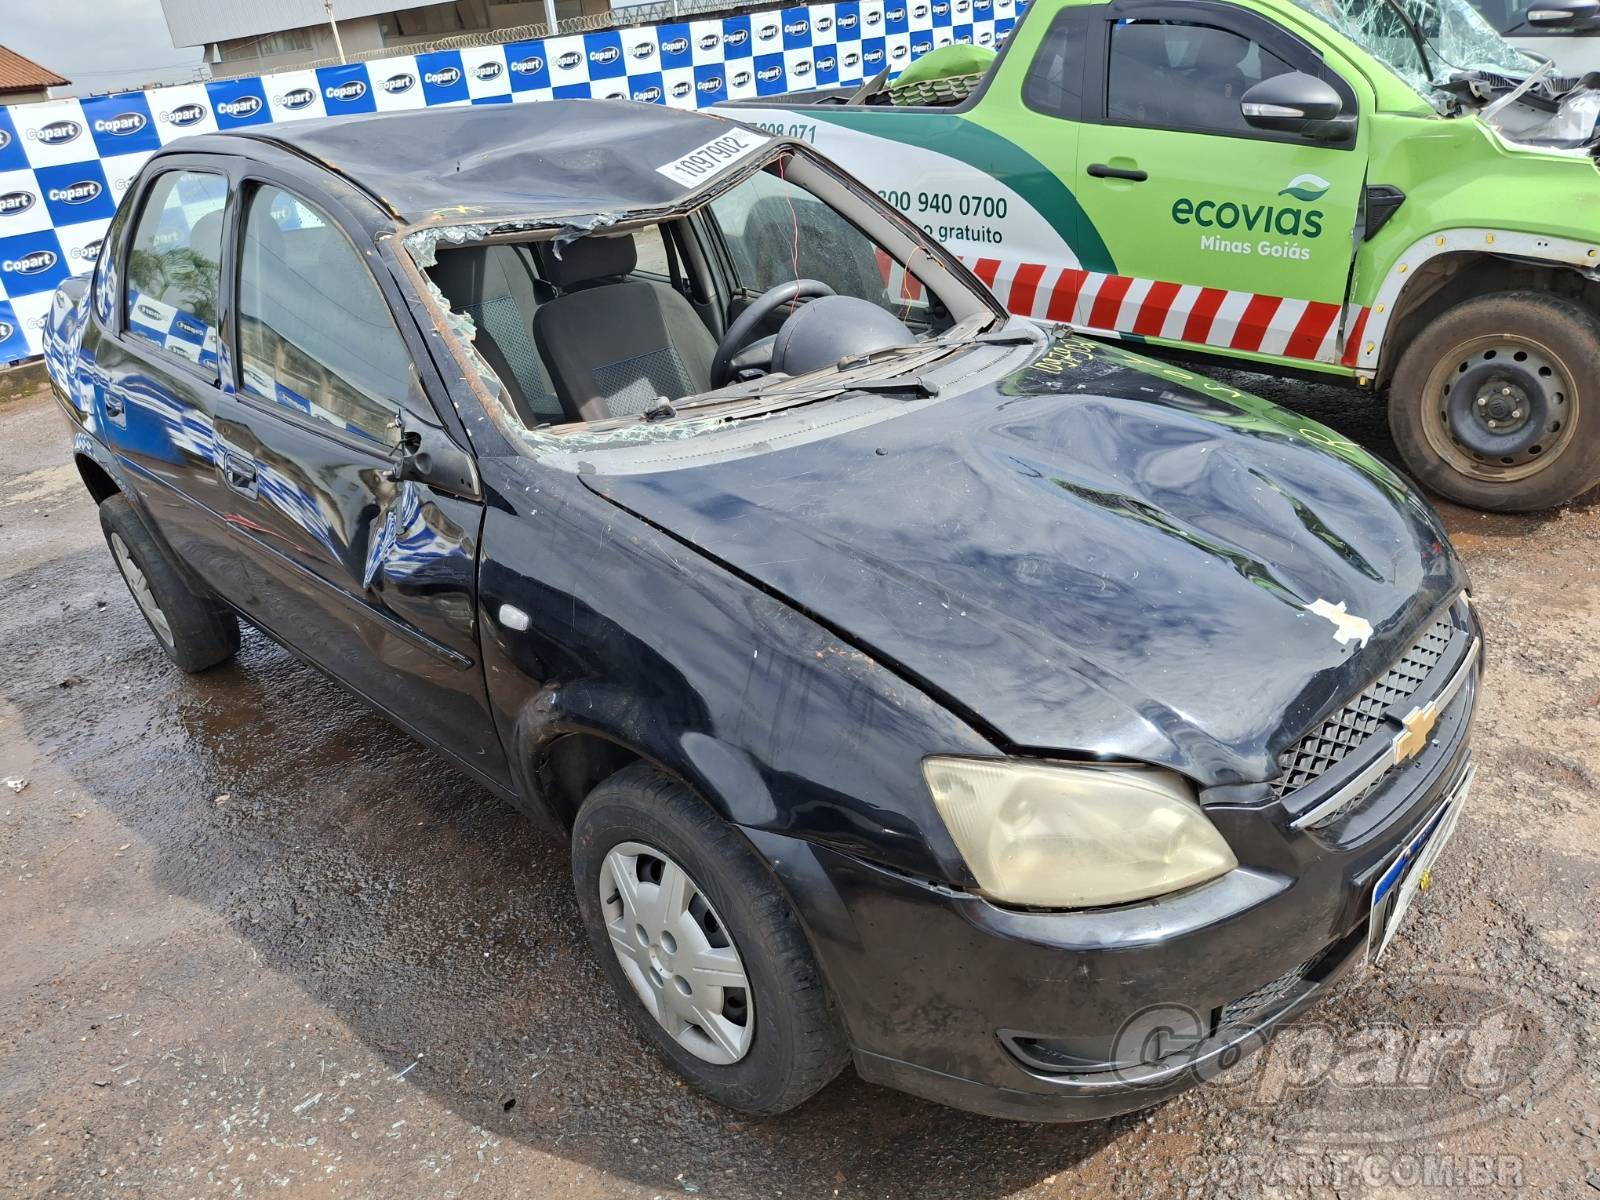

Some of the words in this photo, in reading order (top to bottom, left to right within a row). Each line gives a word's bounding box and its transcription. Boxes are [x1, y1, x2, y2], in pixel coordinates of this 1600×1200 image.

[785, 22, 807, 33] Copart
[723, 31, 745, 43] Copart
[662, 39, 685, 52] Copart
[551, 54, 579, 67] Copart
[590, 50, 616, 62] Copart
[470, 64, 499, 78] Copart
[511, 60, 540, 73] Copart
[758, 67, 780, 79] Copart
[376, 75, 410, 91] Copart
[425, 69, 457, 84] Copart
[326, 83, 362, 99] Copart
[698, 79, 720, 92] Copart
[273, 91, 311, 107] Copart
[634, 88, 658, 102] Copart
[159, 107, 201, 123] Copart
[218, 99, 257, 115] Copart
[95, 114, 141, 133] Copart
[26, 123, 75, 142] Copart
[675, 136, 749, 177] 1097902
[49, 183, 95, 202] Copart
[0, 194, 28, 211] part
[918, 192, 951, 214] 940
[959, 195, 1008, 219] 0700
[1171, 198, 1325, 239] ecovias
[939, 225, 1003, 244] gratuito
[71, 244, 102, 259] Copa
[1201, 235, 1252, 254] Minas
[1257, 241, 1311, 260] Goiás
[3, 253, 51, 273] Copart
